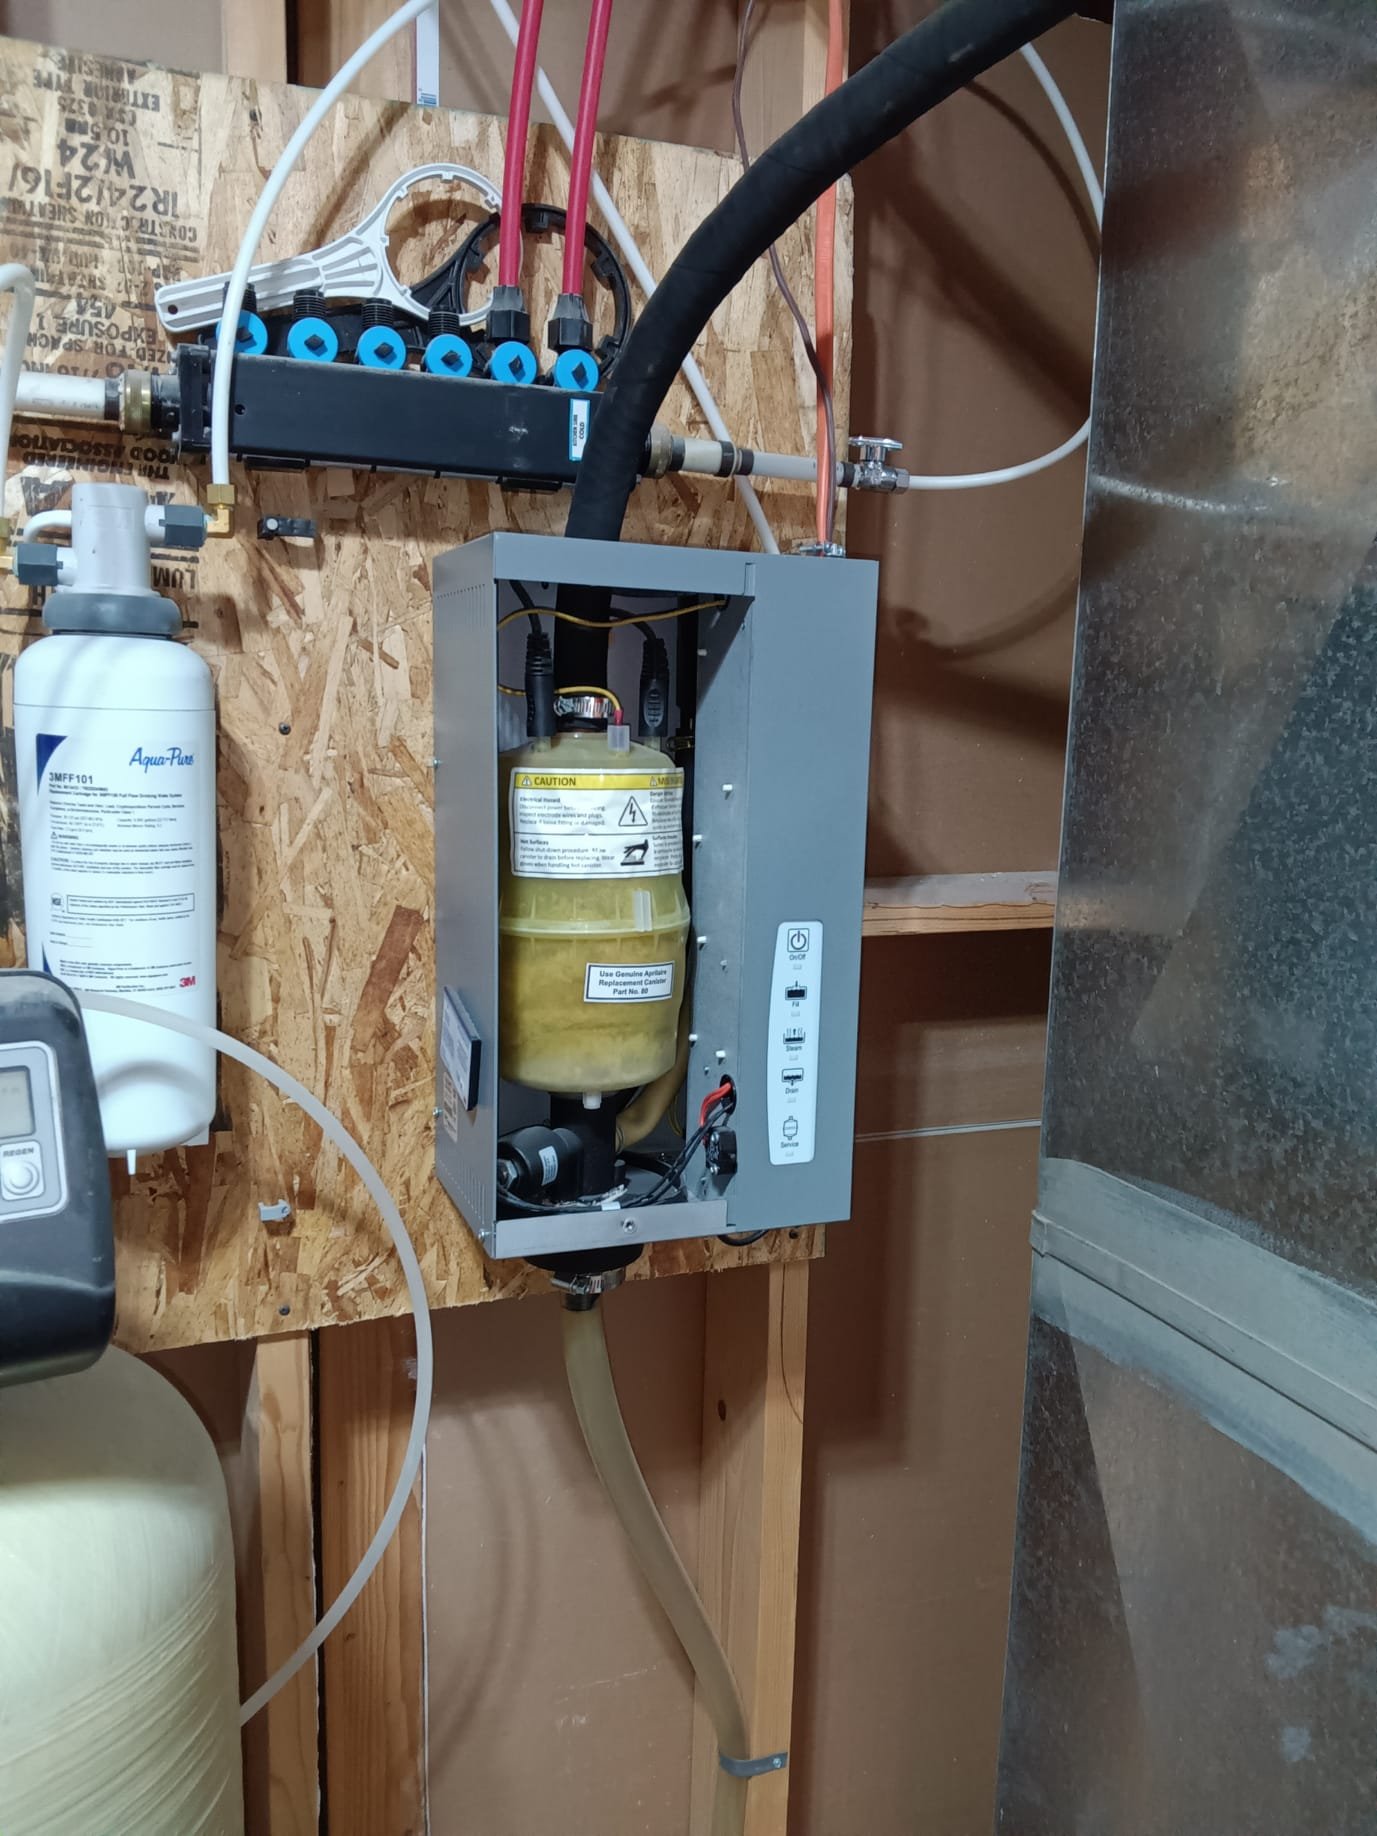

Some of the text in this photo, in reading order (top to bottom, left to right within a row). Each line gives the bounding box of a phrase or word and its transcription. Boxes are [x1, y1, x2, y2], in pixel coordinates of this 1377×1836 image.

[52, 315, 157, 346] EXPOSURE
[93, 340, 128, 358] FOR
[129, 746, 195, 773] Aqua-Pure
[49, 772, 93, 785] 3MFF101
[534, 776, 577, 787] CAUTION
[599, 970, 614, 978] Use
[615, 970, 643, 979] Genuine
[179, 975, 196, 988] 3M
[598, 978, 643, 989] Replacement
[613, 988, 628, 996] Part
[628, 987, 640, 995] No.
[785, 1044, 803, 1052] Steam
[784, 1086, 799, 1095] Drain
[780, 1140, 800, 1149] Service
[3, 1147, 35, 1158] REGEN
